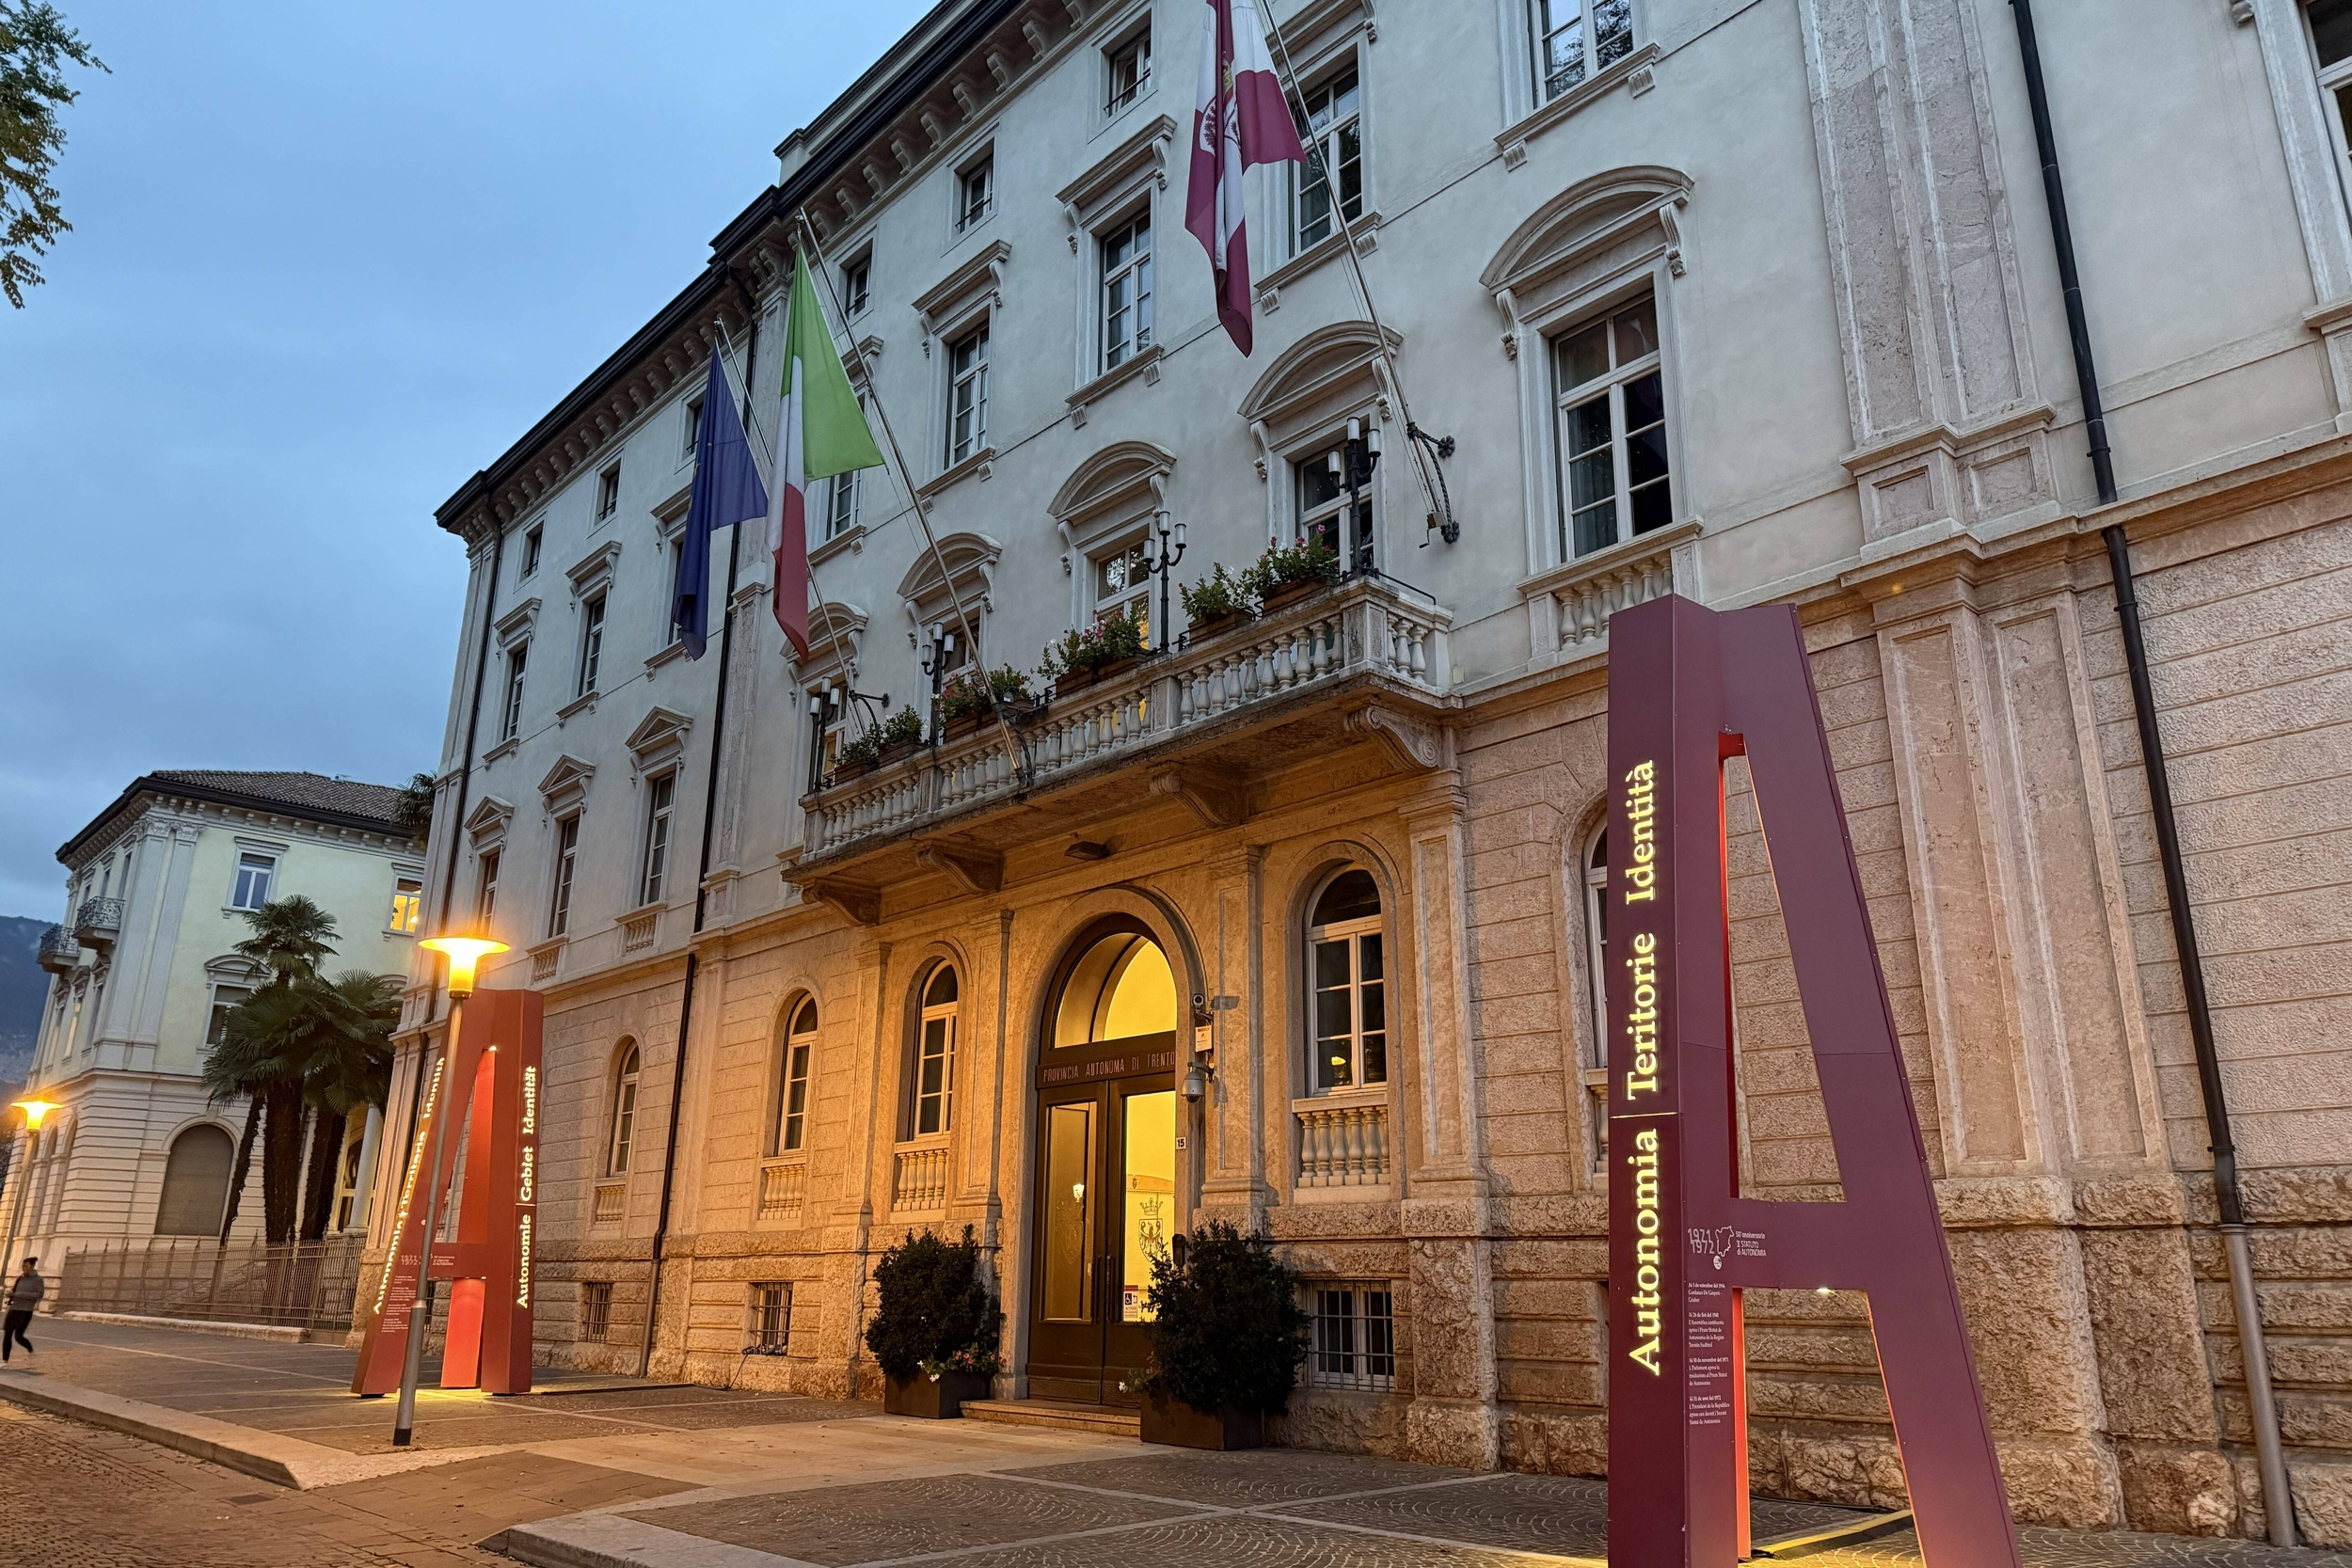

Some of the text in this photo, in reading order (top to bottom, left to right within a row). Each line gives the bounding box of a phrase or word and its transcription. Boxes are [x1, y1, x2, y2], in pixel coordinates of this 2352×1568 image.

[1043, 1051, 1175, 1083] PROVINCIA AUTONOMA DI TRENTO
[1625, 759, 1660, 1376] Autonomia Teritorie Identità
[1177, 1139, 1184, 1148] 15
[517, 1066, 537, 1308] Autonomie Gebiet Identität
[1687, 1228, 1712, 1243] 1971
[1691, 1240, 1715, 1254] 1972
